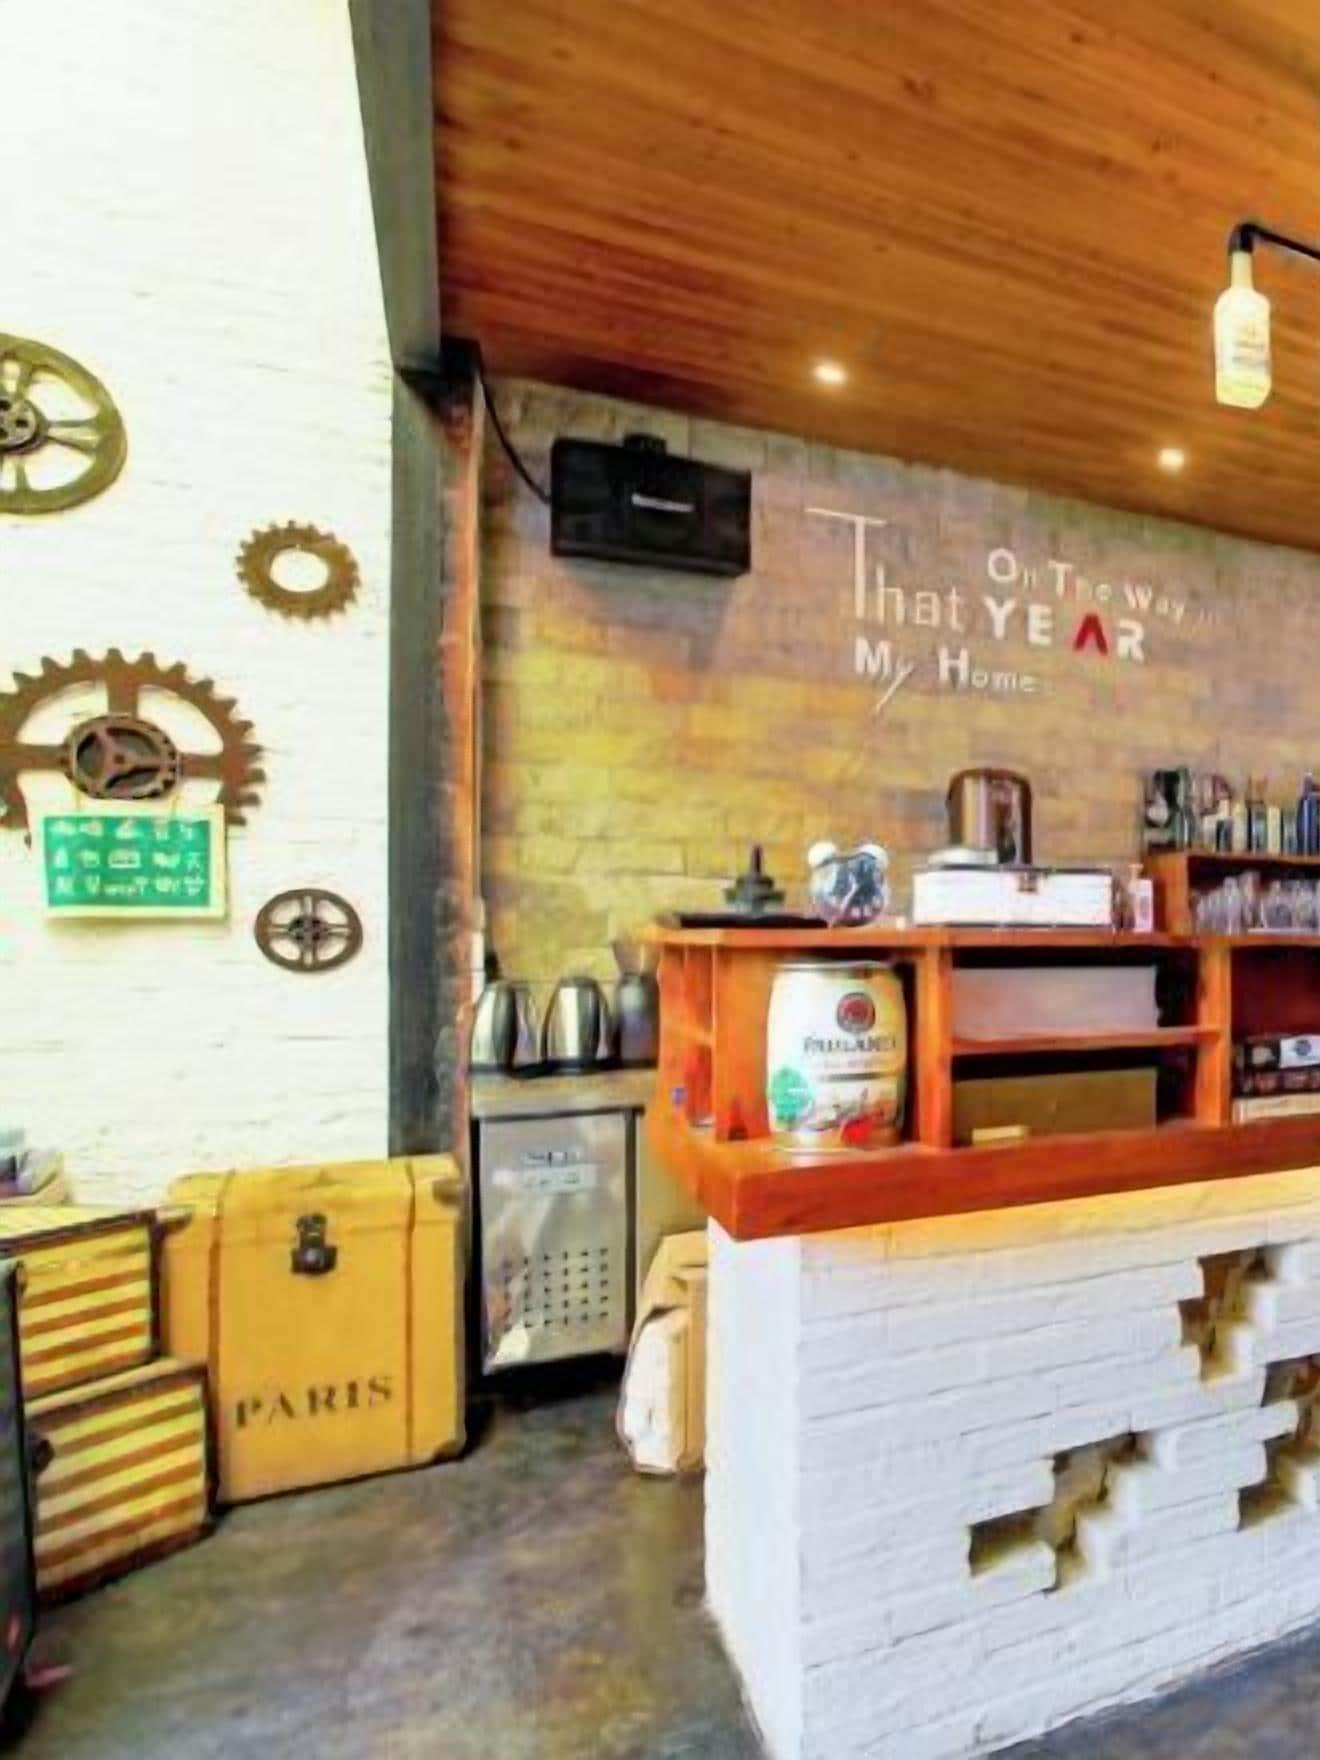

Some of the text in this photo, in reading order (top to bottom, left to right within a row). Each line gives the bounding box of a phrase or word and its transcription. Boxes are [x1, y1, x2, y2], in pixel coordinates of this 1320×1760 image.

[805, 506, 1147, 663] That YEAR
[987, 547, 1037, 588] On
[854, 634, 1037, 714] My Home
[236, 1373, 393, 1429] PARIS
